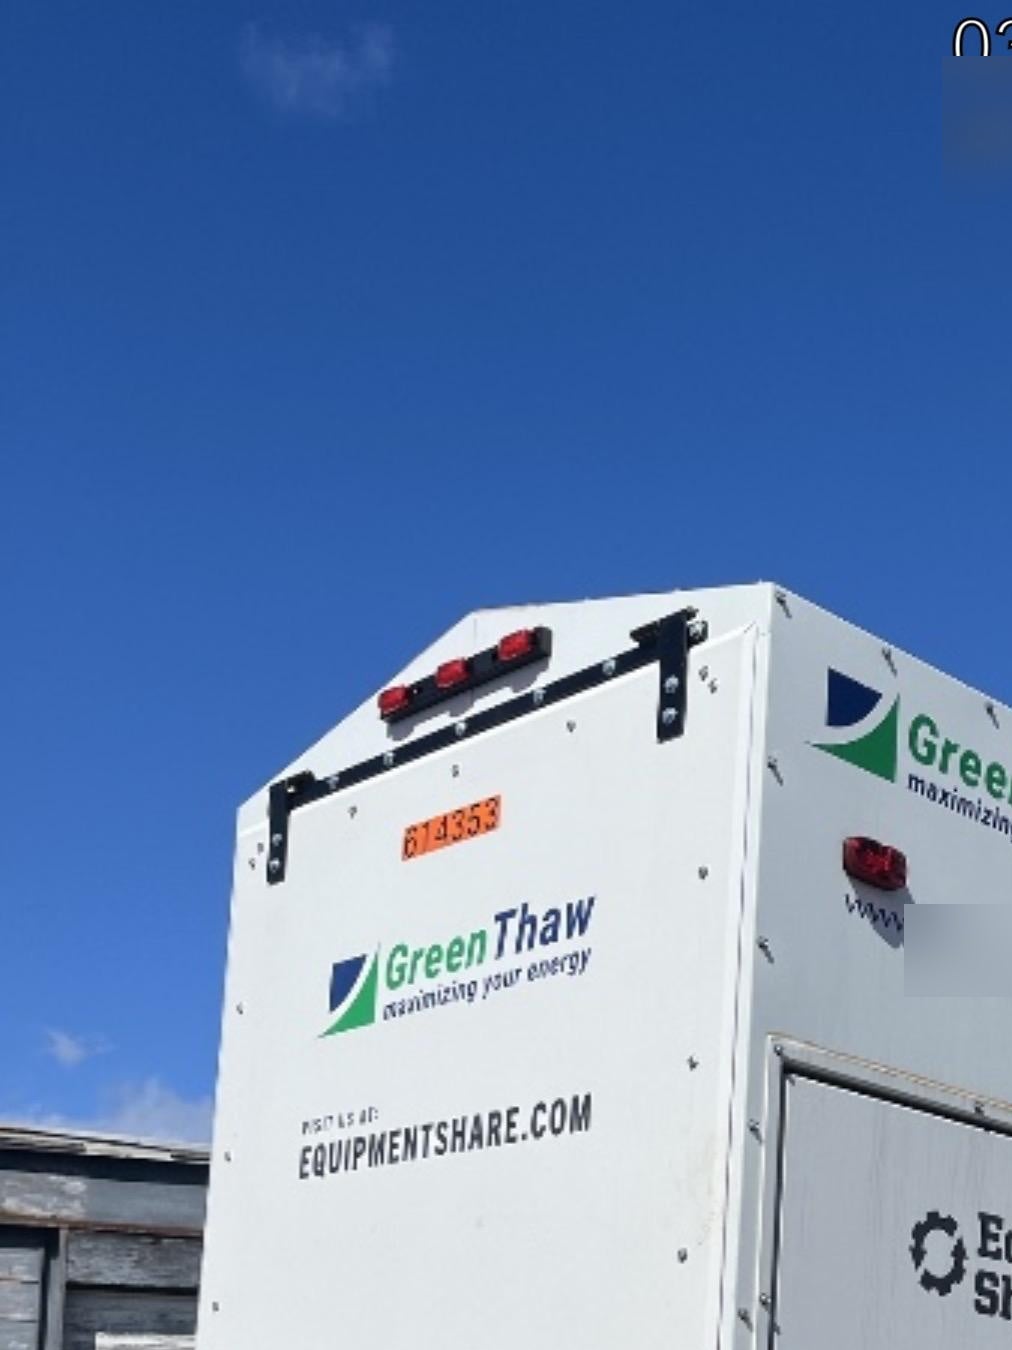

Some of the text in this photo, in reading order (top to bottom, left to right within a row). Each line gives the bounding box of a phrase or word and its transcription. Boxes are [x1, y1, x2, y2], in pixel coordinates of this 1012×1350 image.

[382, 948, 592, 1021] maximizing your energy
[385, 896, 596, 991] GreenThaw
[299, 1093, 592, 1180] EQUIPMENTSHARE.COM
